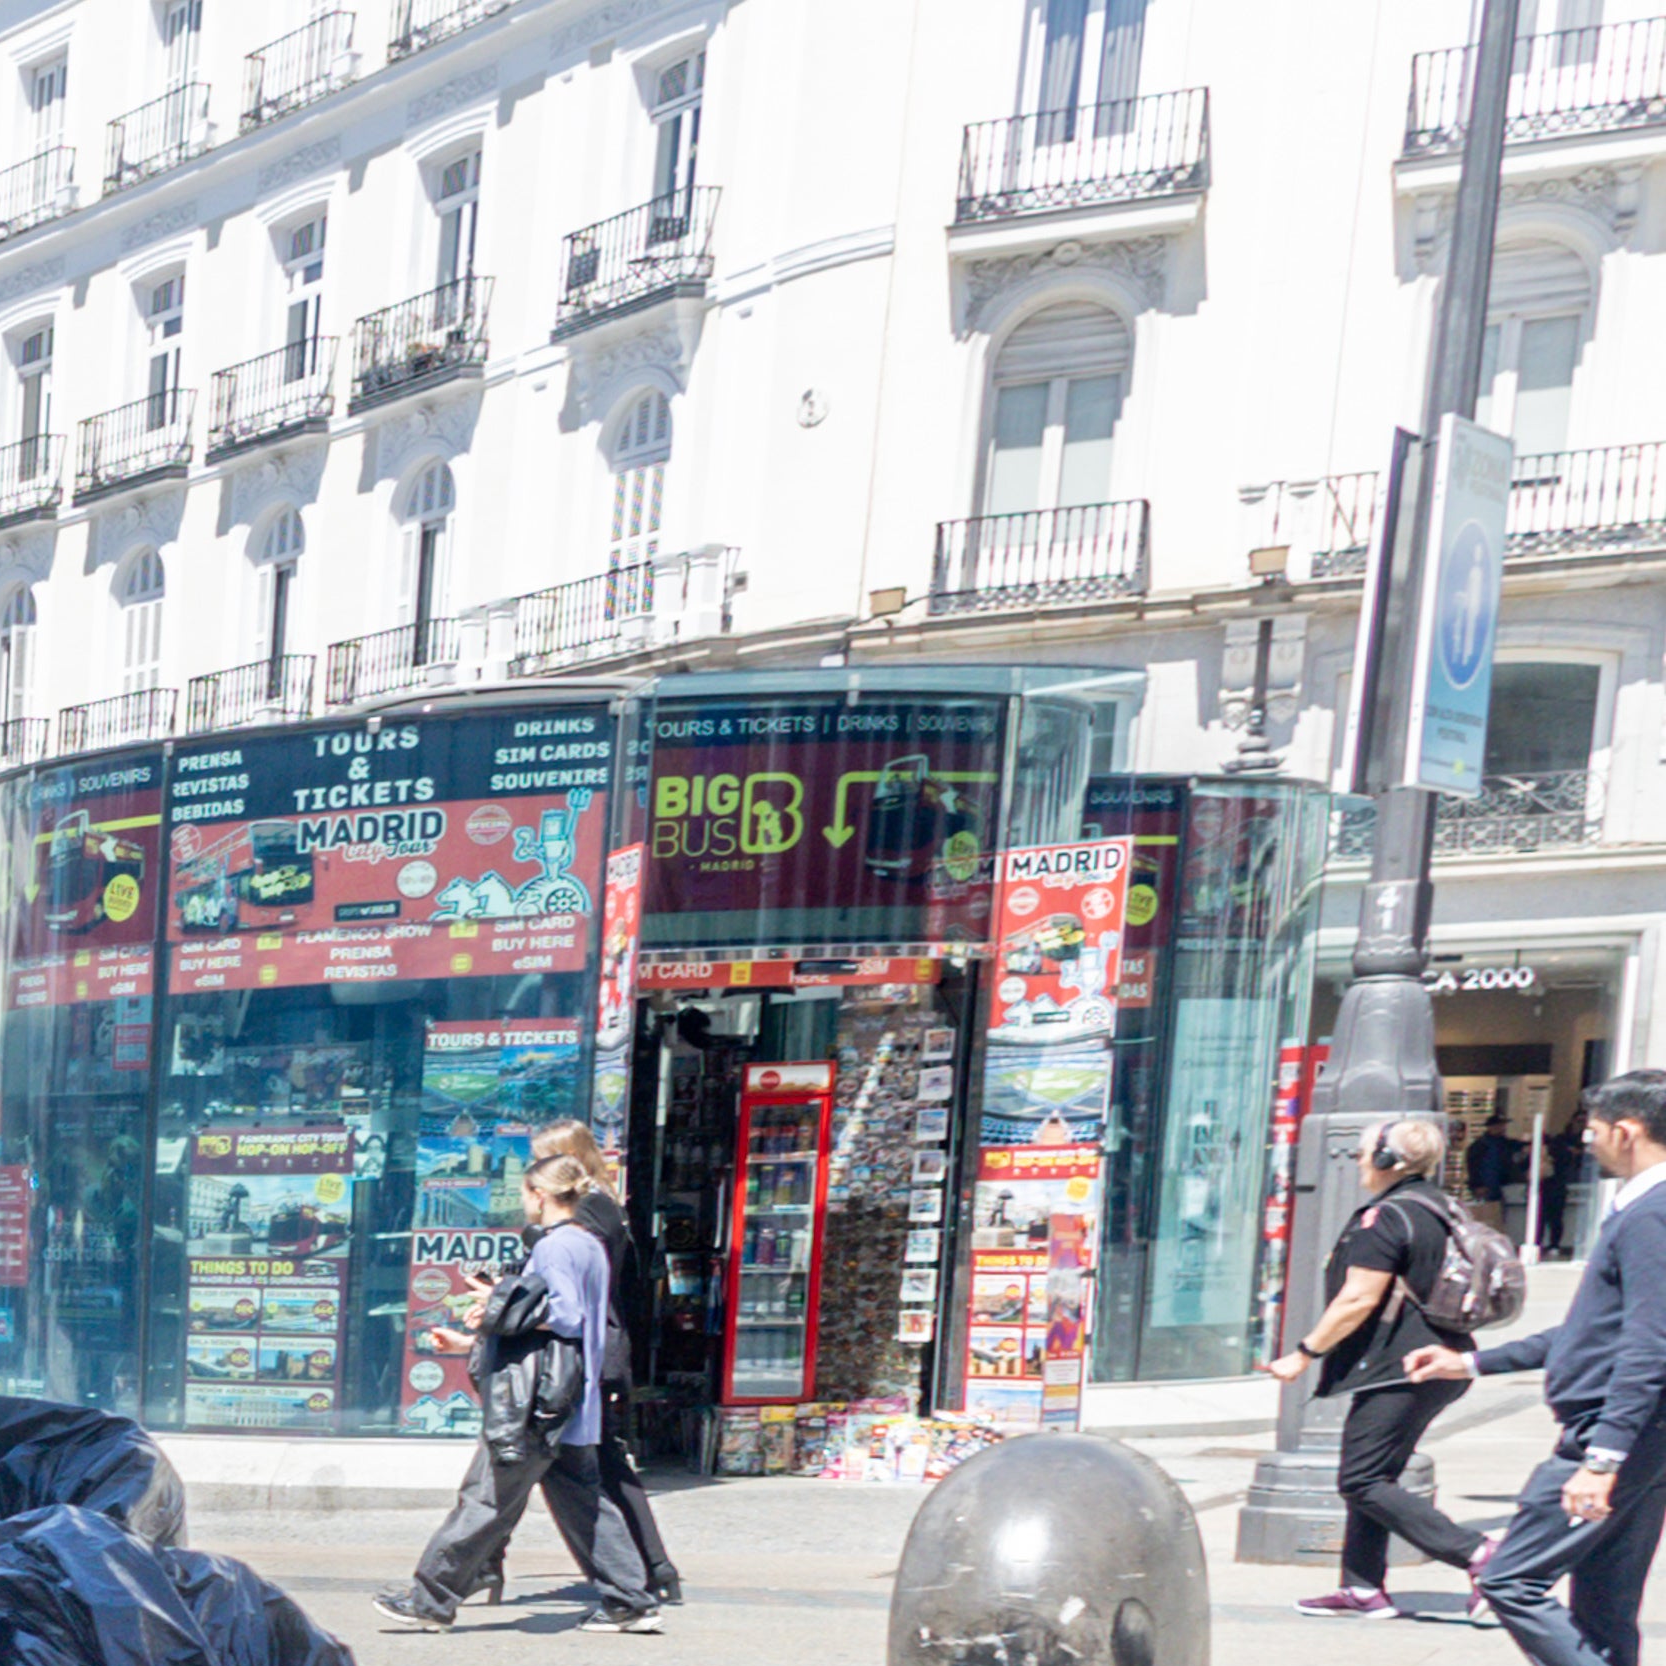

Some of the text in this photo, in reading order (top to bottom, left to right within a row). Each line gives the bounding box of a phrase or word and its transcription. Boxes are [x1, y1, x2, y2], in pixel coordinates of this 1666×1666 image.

[514, 716, 595, 738] DRINKS
[737, 714, 816, 735] TICKETS
[836, 713, 899, 733] DRINKS
[313, 725, 420, 757] TOURS
[494, 747, 536, 765] SIM
[540, 741, 611, 762] CARDS
[178, 750, 243, 773] PRENSA
[348, 756, 371, 781] &
[78, 765, 152, 793] SOUVENIRS
[173, 773, 250, 798] REVISTAS
[293, 777, 436, 812] TICKETS
[654, 773, 741, 818] BIG
[172, 798, 245, 822] BEBIDAS
[298, 808, 445, 853] MADRID
[652, 818, 737, 859] BUS
[1010, 847, 1123, 881] MADRID
[530, 914, 576, 931] CARD
[330, 945, 393, 960] PRENSA
[492, 933, 576, 953] BUY HERE
[323, 963, 398, 979] REVISTAS
[657, 962, 714, 980] CARD
[1461, 965, 1537, 991] 2000
[428, 1032, 485, 1047] TOURS
[504, 1029, 578, 1045] TICKETS
[190, 1259, 295, 1276] THINGS TO DO
